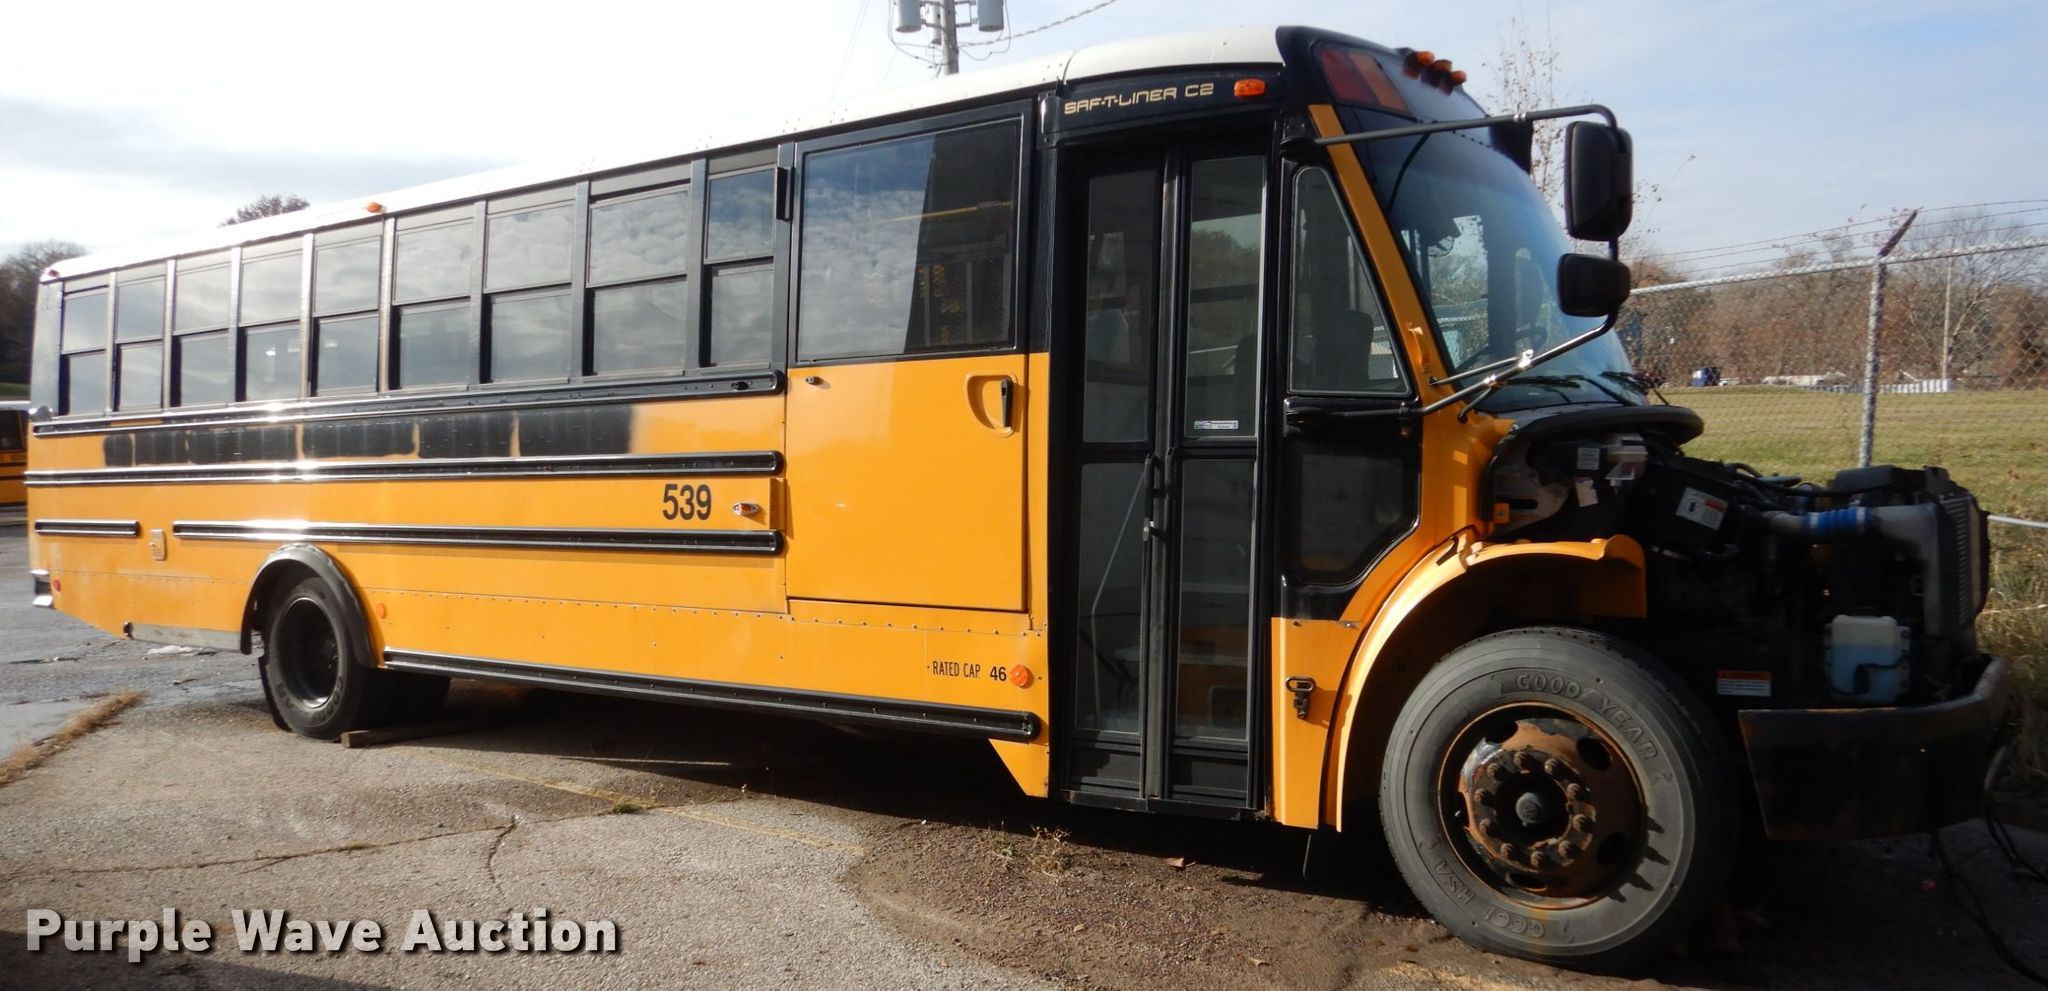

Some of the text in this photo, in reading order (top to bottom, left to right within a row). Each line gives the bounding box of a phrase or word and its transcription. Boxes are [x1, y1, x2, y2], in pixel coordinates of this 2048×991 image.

[1184, 82, 1215, 98] C2
[662, 483, 712, 520] 539
[932, 660, 960, 677] RATED
[989, 666, 1007, 682] 46
[1515, 673, 1659, 761] GOOD YEAR
